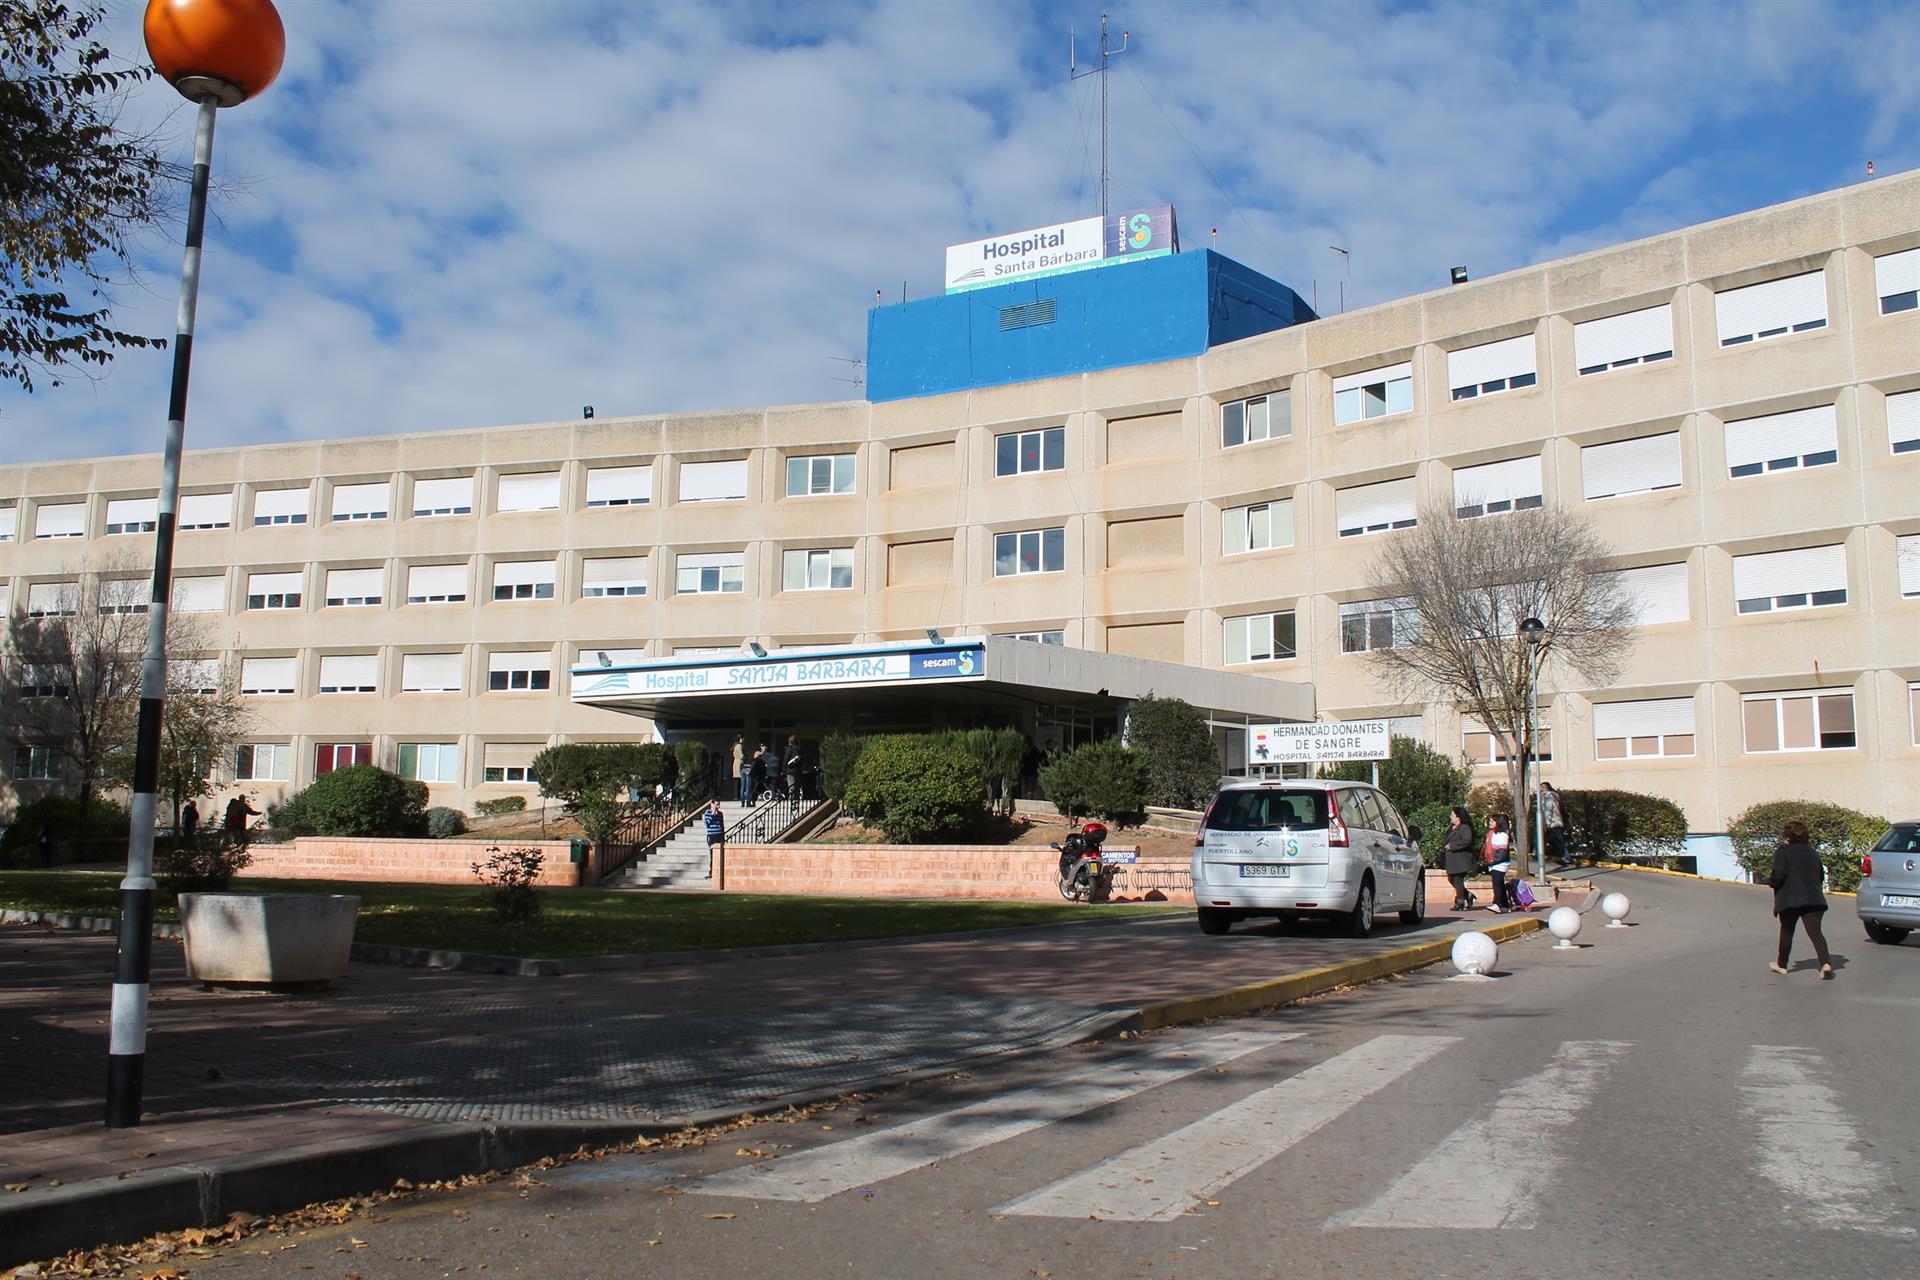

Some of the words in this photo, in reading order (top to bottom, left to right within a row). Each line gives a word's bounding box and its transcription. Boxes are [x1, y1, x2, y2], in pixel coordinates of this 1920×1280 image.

[983, 229, 1065, 260] Hospital
[994, 260, 1035, 276] Santa
[1040, 248, 1098, 268] Bárbara
[923, 658, 956, 668] sescam
[646, 671, 709, 690] Hospital
[727, 665, 788, 684] SANTA
[1273, 726, 1330, 738] HERMANDAD
[1332, 723, 1384, 735] DONANTES
[1295, 740, 1310, 750] DE
[1315, 738, 1361, 750] SANGRE
[1273, 753, 1312, 761] HOSPITAL
[1316, 751, 1345, 759] SANTA
[1101, 851, 1135, 859] CAMIENTOS
[1245, 866, 1267, 875] 5369
[1270, 866, 1287, 875] GTX
